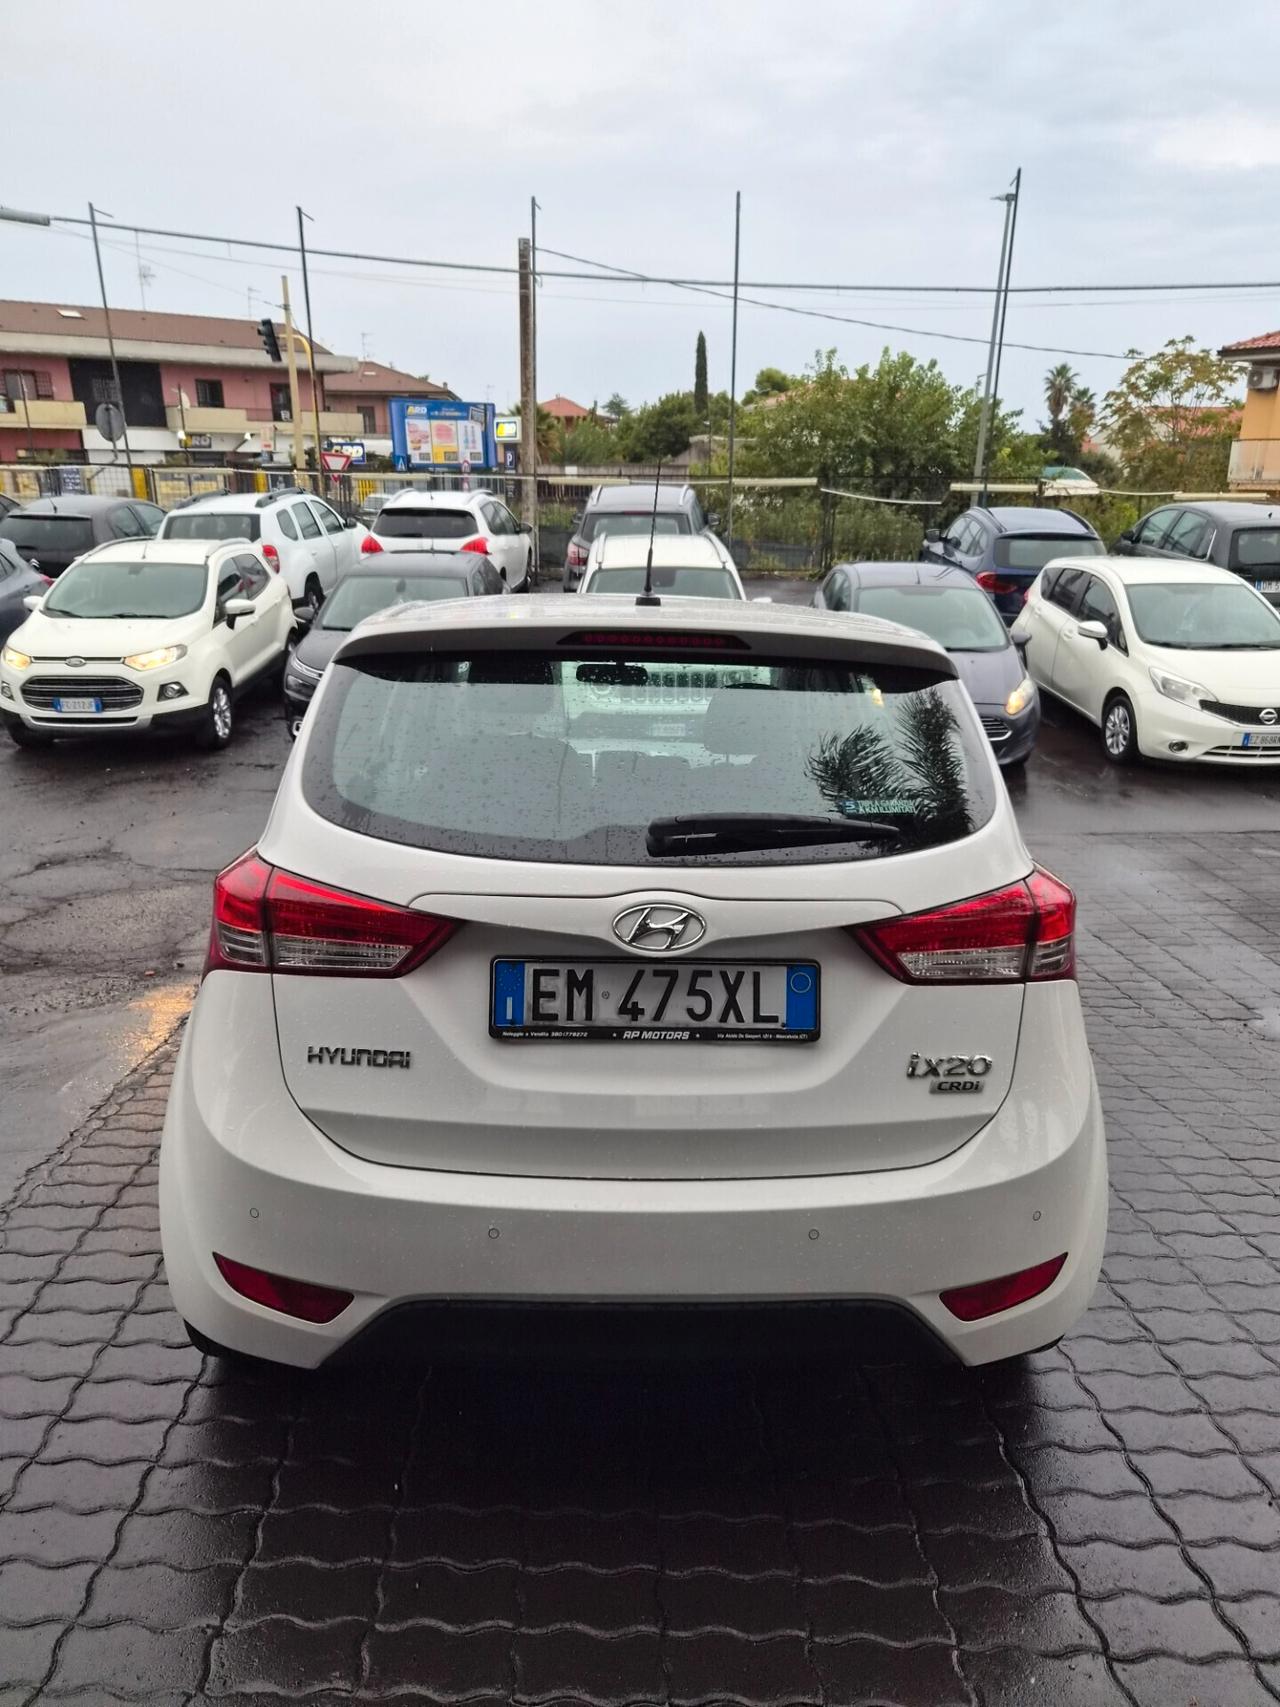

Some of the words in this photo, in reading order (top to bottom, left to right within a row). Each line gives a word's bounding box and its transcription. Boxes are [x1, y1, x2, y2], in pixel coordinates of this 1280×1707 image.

[532, 969, 593, 1021] EM
[618, 969, 779, 1023] 475XL
[641, 1030, 690, 1040] MOTORS
[307, 1046, 411, 1069] HYUNDAI
[937, 1081, 980, 1091] CRDi
